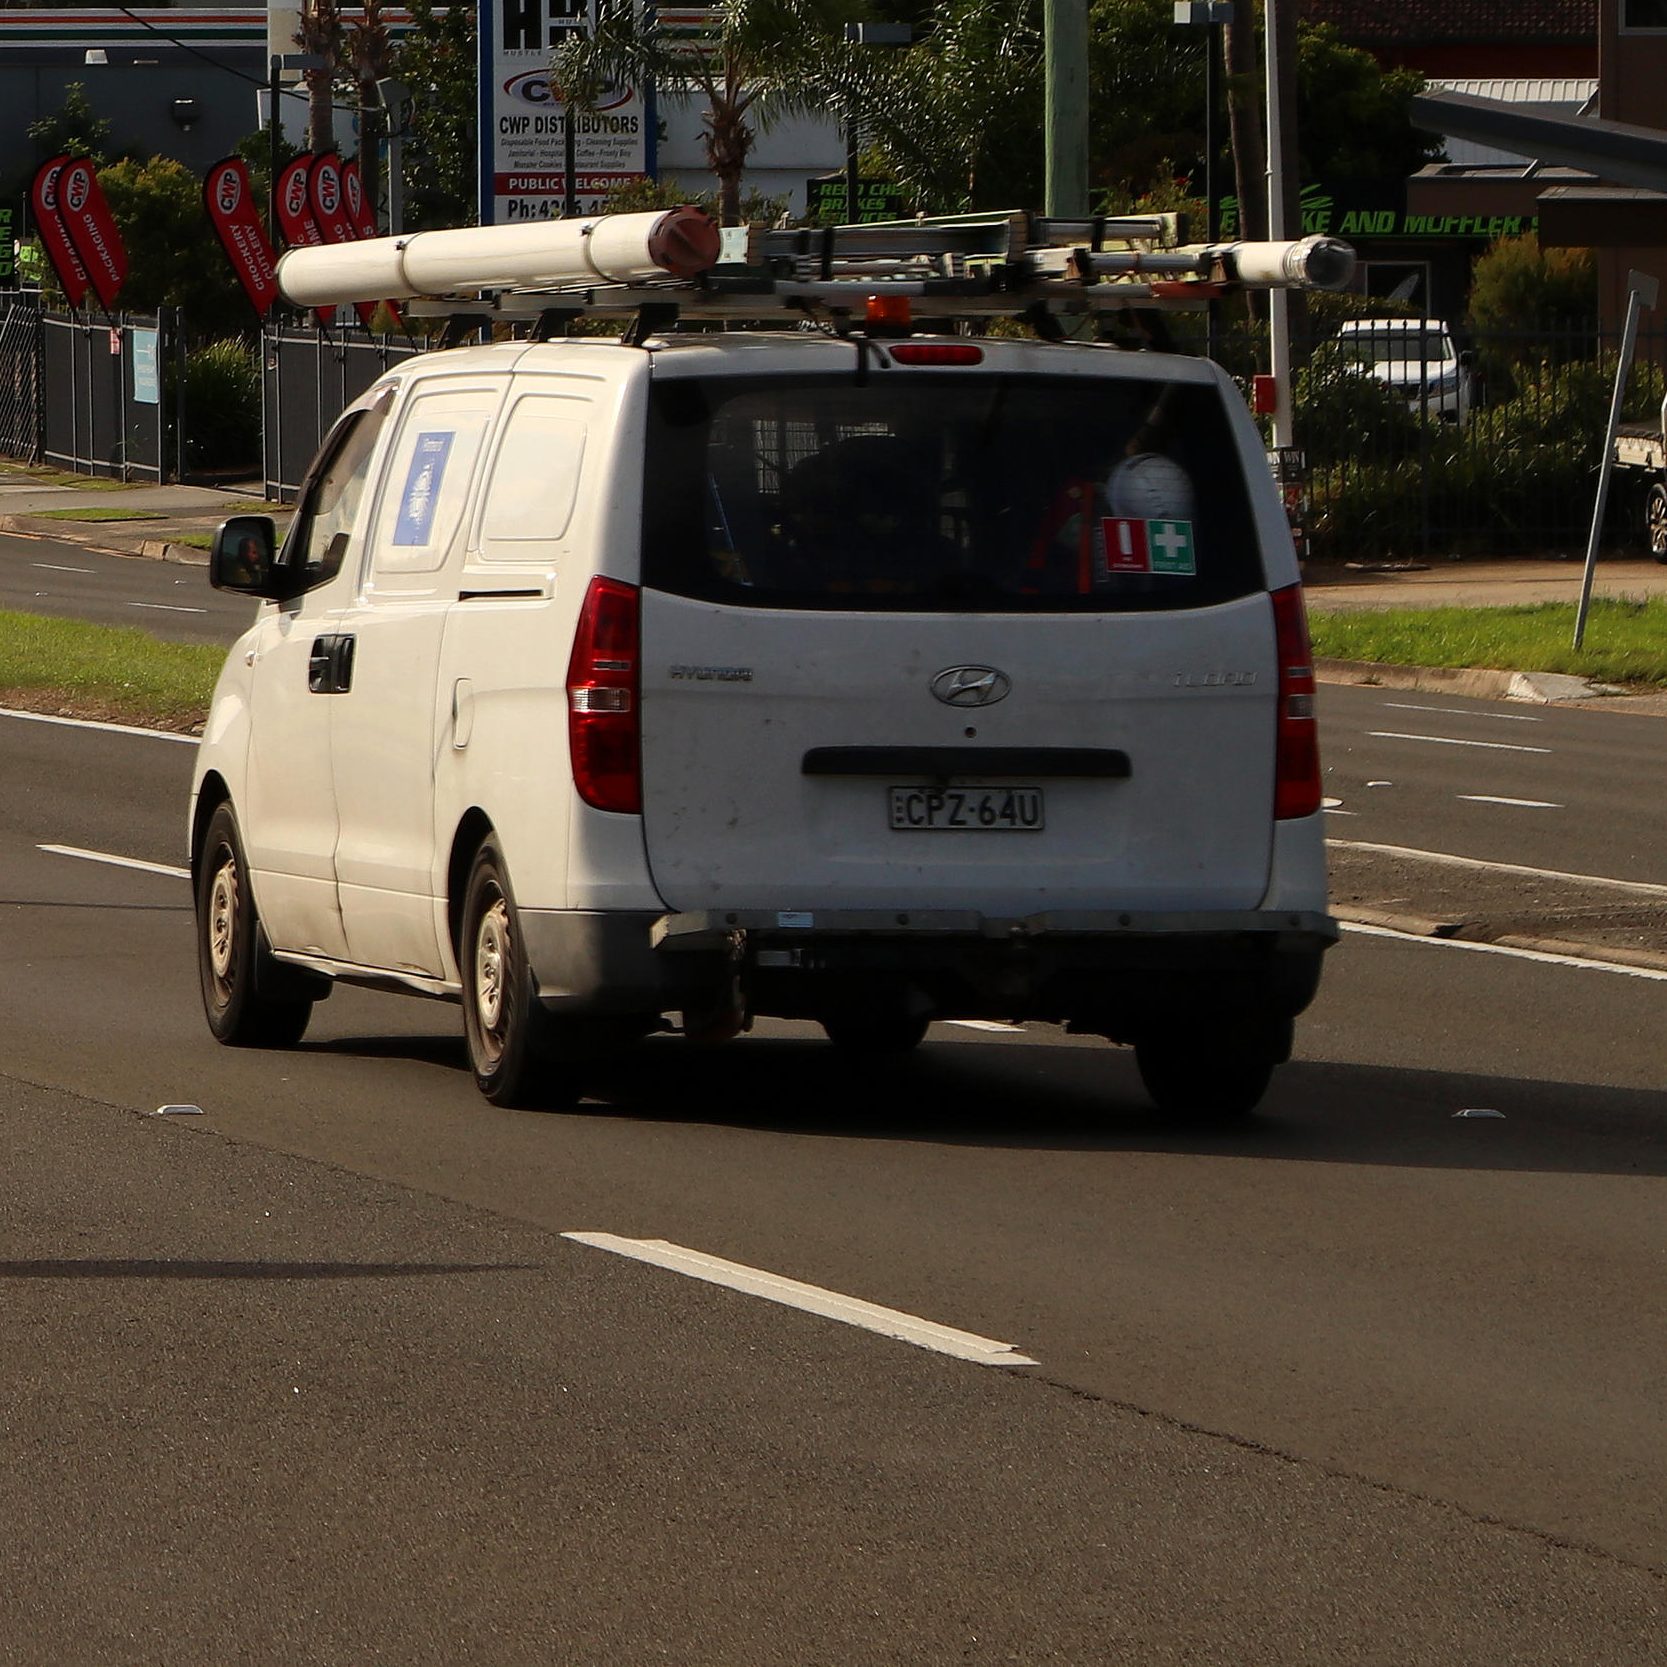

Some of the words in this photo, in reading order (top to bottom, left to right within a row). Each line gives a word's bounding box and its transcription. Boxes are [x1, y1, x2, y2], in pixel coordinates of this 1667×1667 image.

[500, 116, 530, 134] CWP
[535, 116, 639, 134] DISTIBUTORS
[551, 138, 581, 147] Packng
[70, 172, 85, 208] CWP
[220, 171, 237, 210] CWP
[289, 172, 305, 213] CWP
[323, 170, 337, 210] CWP
[509, 178, 559, 189] PUBLIC
[508, 199, 536, 218] Ph:
[1340, 211, 1395, 233] AND
[83, 214, 120, 281] PACKAGING
[229, 224, 265, 291] CROCKERY
[245, 225, 277, 280] CUTLERY
